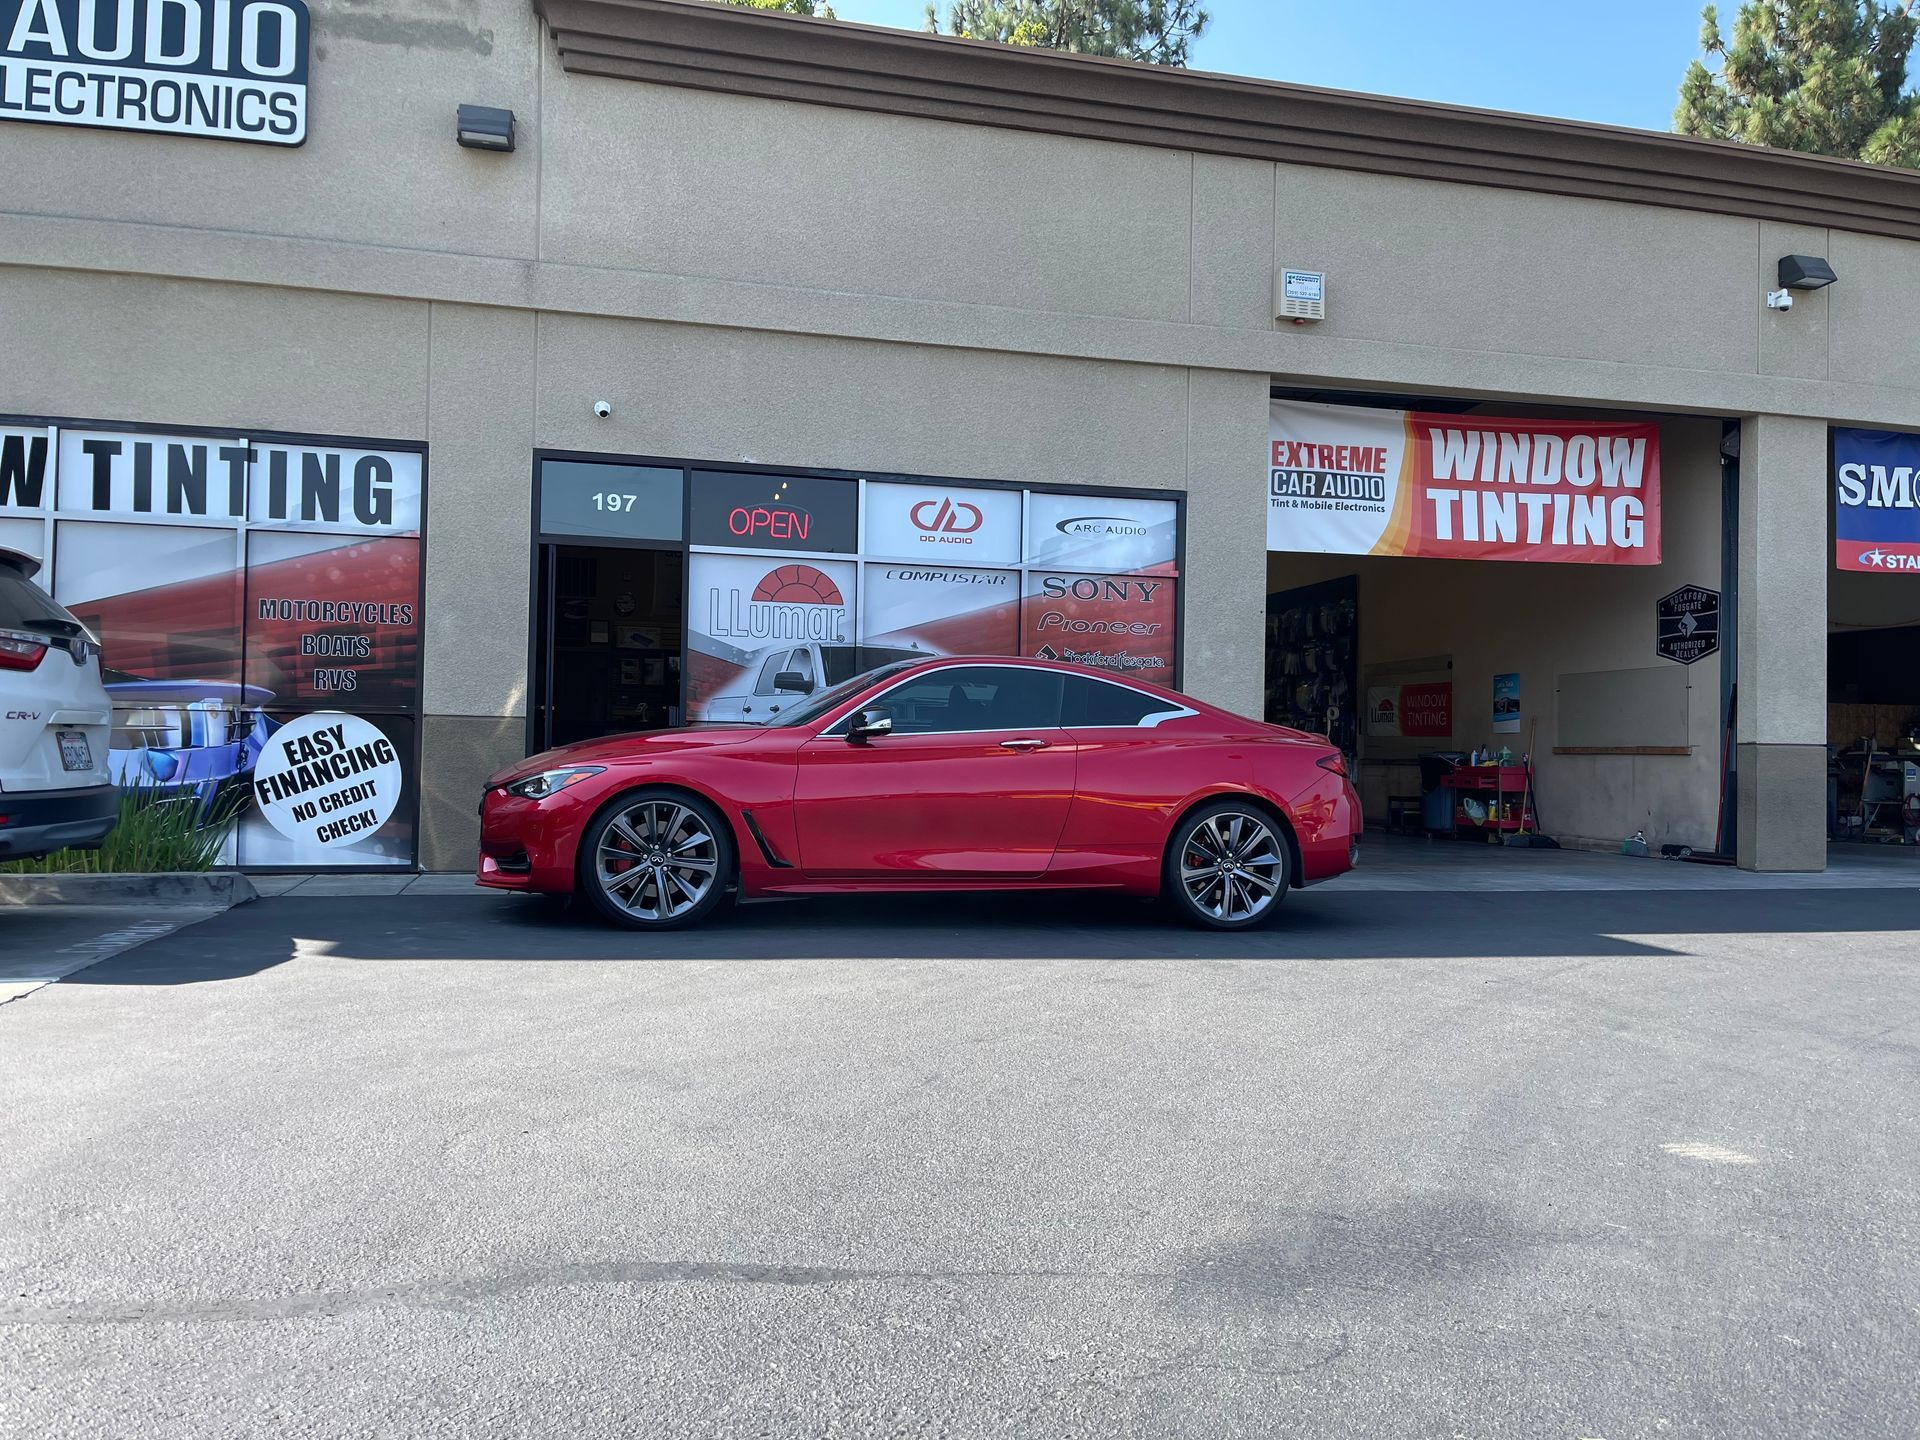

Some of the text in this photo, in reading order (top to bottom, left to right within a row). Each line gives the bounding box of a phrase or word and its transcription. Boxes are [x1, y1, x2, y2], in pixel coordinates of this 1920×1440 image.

[7, 0, 297, 76] AUDIO
[0, 65, 298, 135] LECTRONICS
[1272, 441, 1387, 473] EXTREME
[1428, 428, 1646, 488] WINDOW
[83, 439, 392, 525] TINTING
[1273, 471, 1384, 499] CAR AUDIO
[1838, 463, 1920, 508] SM
[592, 493, 637, 512] 197
[1271, 499, 1386, 513] Tint & Mobile Electronics
[729, 507, 809, 540] OPEN
[1073, 524, 1147, 536] ARC AUDIO
[1426, 488, 1643, 548] TINTING
[919, 535, 973, 544] DD AUDIO
[886, 569, 1007, 585] COMPUSTAR
[1042, 577, 1161, 602] SONY
[258, 598, 413, 626] MOTORCYCLES
[709, 587, 845, 641] LLumar
[1674, 601, 1702, 612] FOSGATE
[1037, 611, 1161, 636] Pioneer
[301, 634, 370, 658] BOATS
[314, 668, 357, 691] RVS
[1406, 694, 1447, 707] WINDOW
[6, 711, 41, 720] CR-V
[1407, 711, 1447, 726] TINTING
[282, 723, 346, 767] EASY
[255, 738, 395, 805] FINANCING
[291, 780, 377, 823] NO CREDIT
[316, 808, 378, 843] CHECK!
